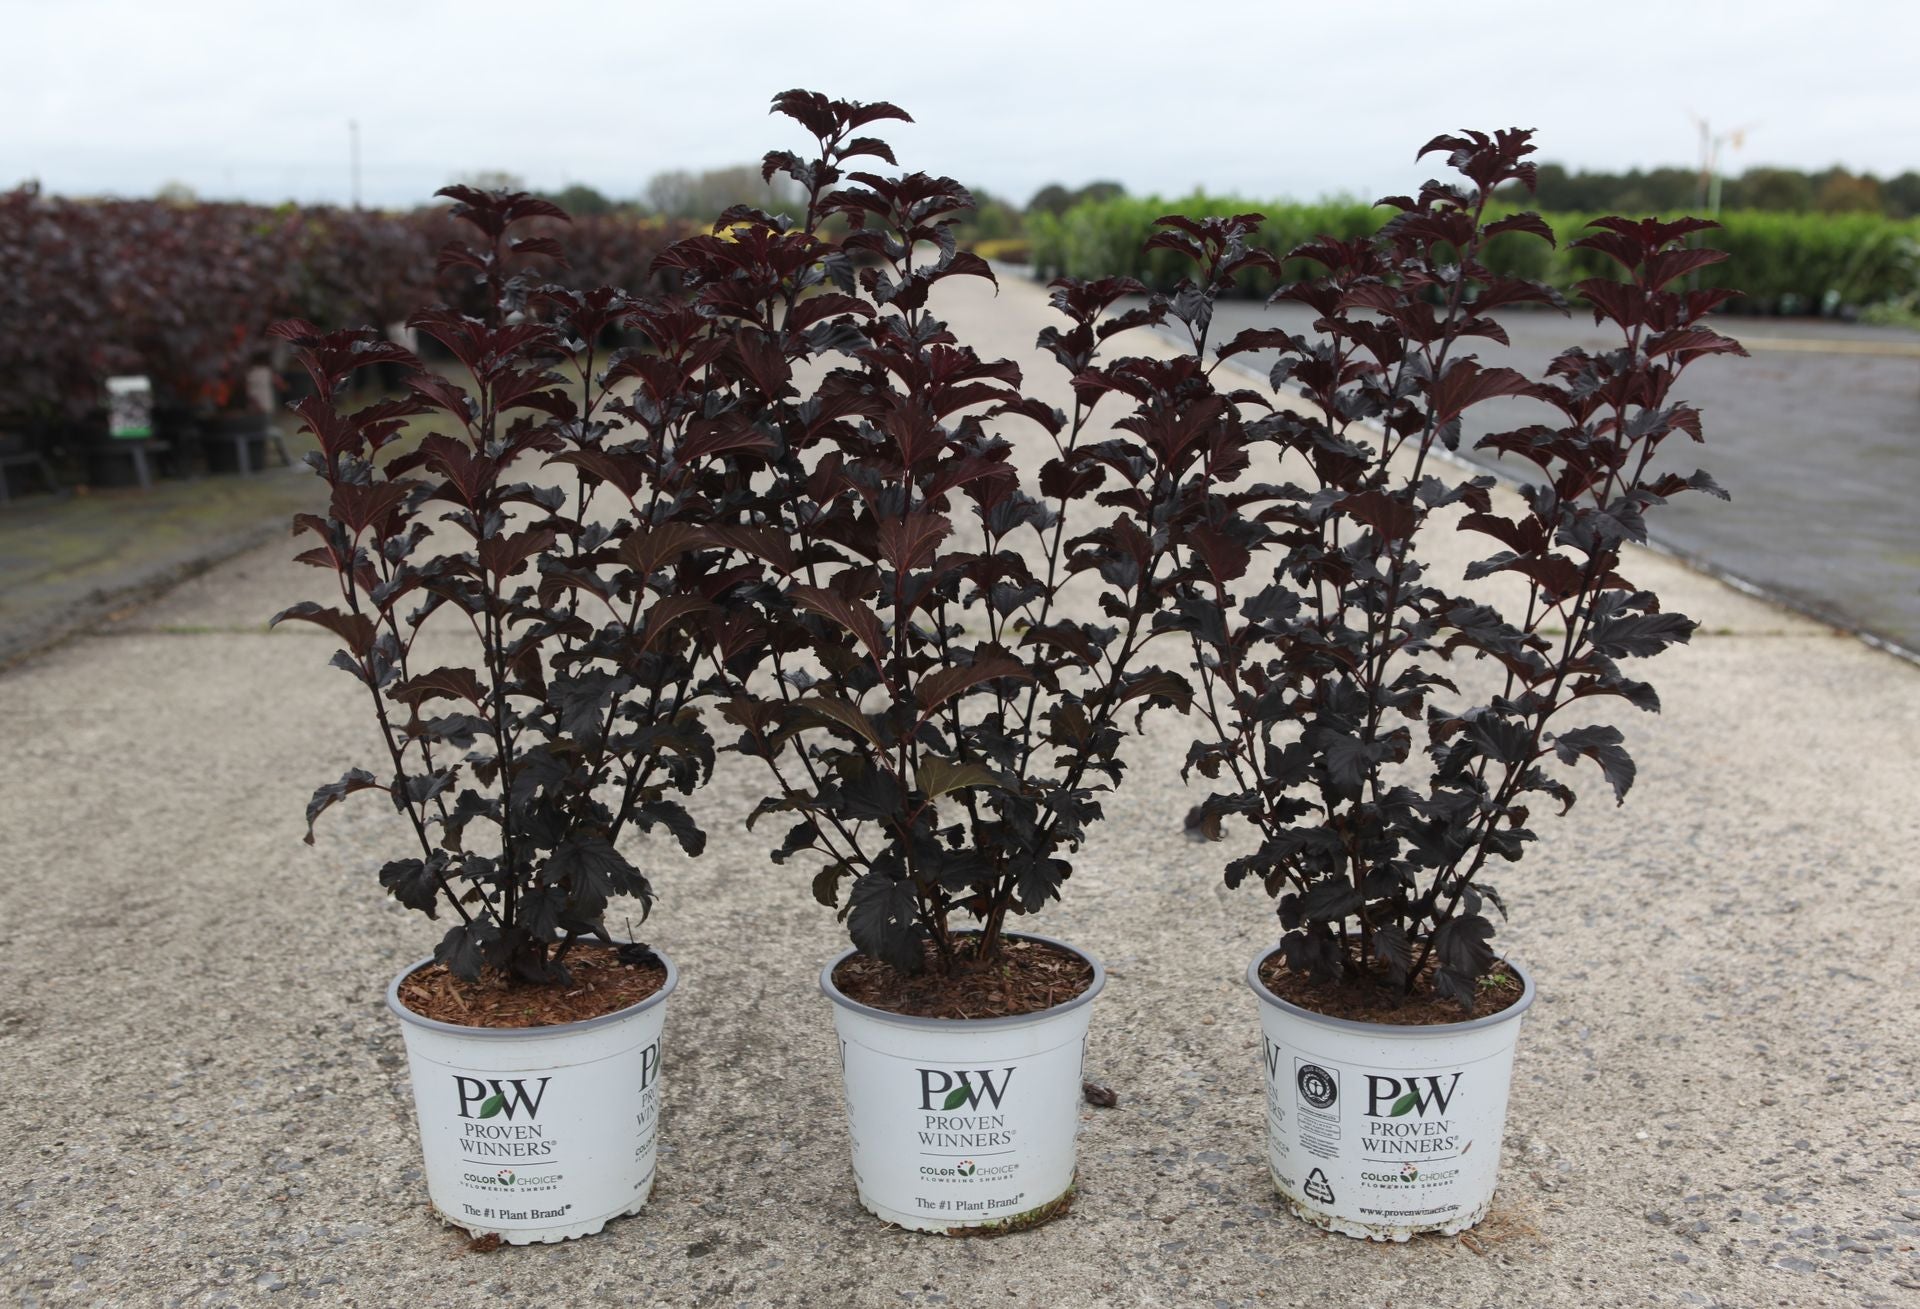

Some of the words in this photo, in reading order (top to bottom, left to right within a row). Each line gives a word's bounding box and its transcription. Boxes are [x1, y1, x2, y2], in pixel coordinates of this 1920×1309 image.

[914, 1066, 1017, 1112] PW
[1363, 1071, 1464, 1118] PW
[452, 1075, 552, 1121] PW
[464, 1122, 542, 1139] PROVEN
[925, 1114, 1004, 1131] PROVEN
[1371, 1120, 1449, 1138] PROVEN
[464, 1173, 496, 1184] COLOR
[920, 1166, 955, 1176] COLOR
[1361, 1172, 1398, 1182] COLOR
[465, 1182, 515, 1192] FLOWERING
[463, 1203, 481, 1216] The
[484, 1208, 495, 1218] #1
[500, 1209, 527, 1220] Plant
[915, 1197, 936, 1209] The
[939, 1200, 951, 1210] #1
[956, 1200, 984, 1211] Plant
